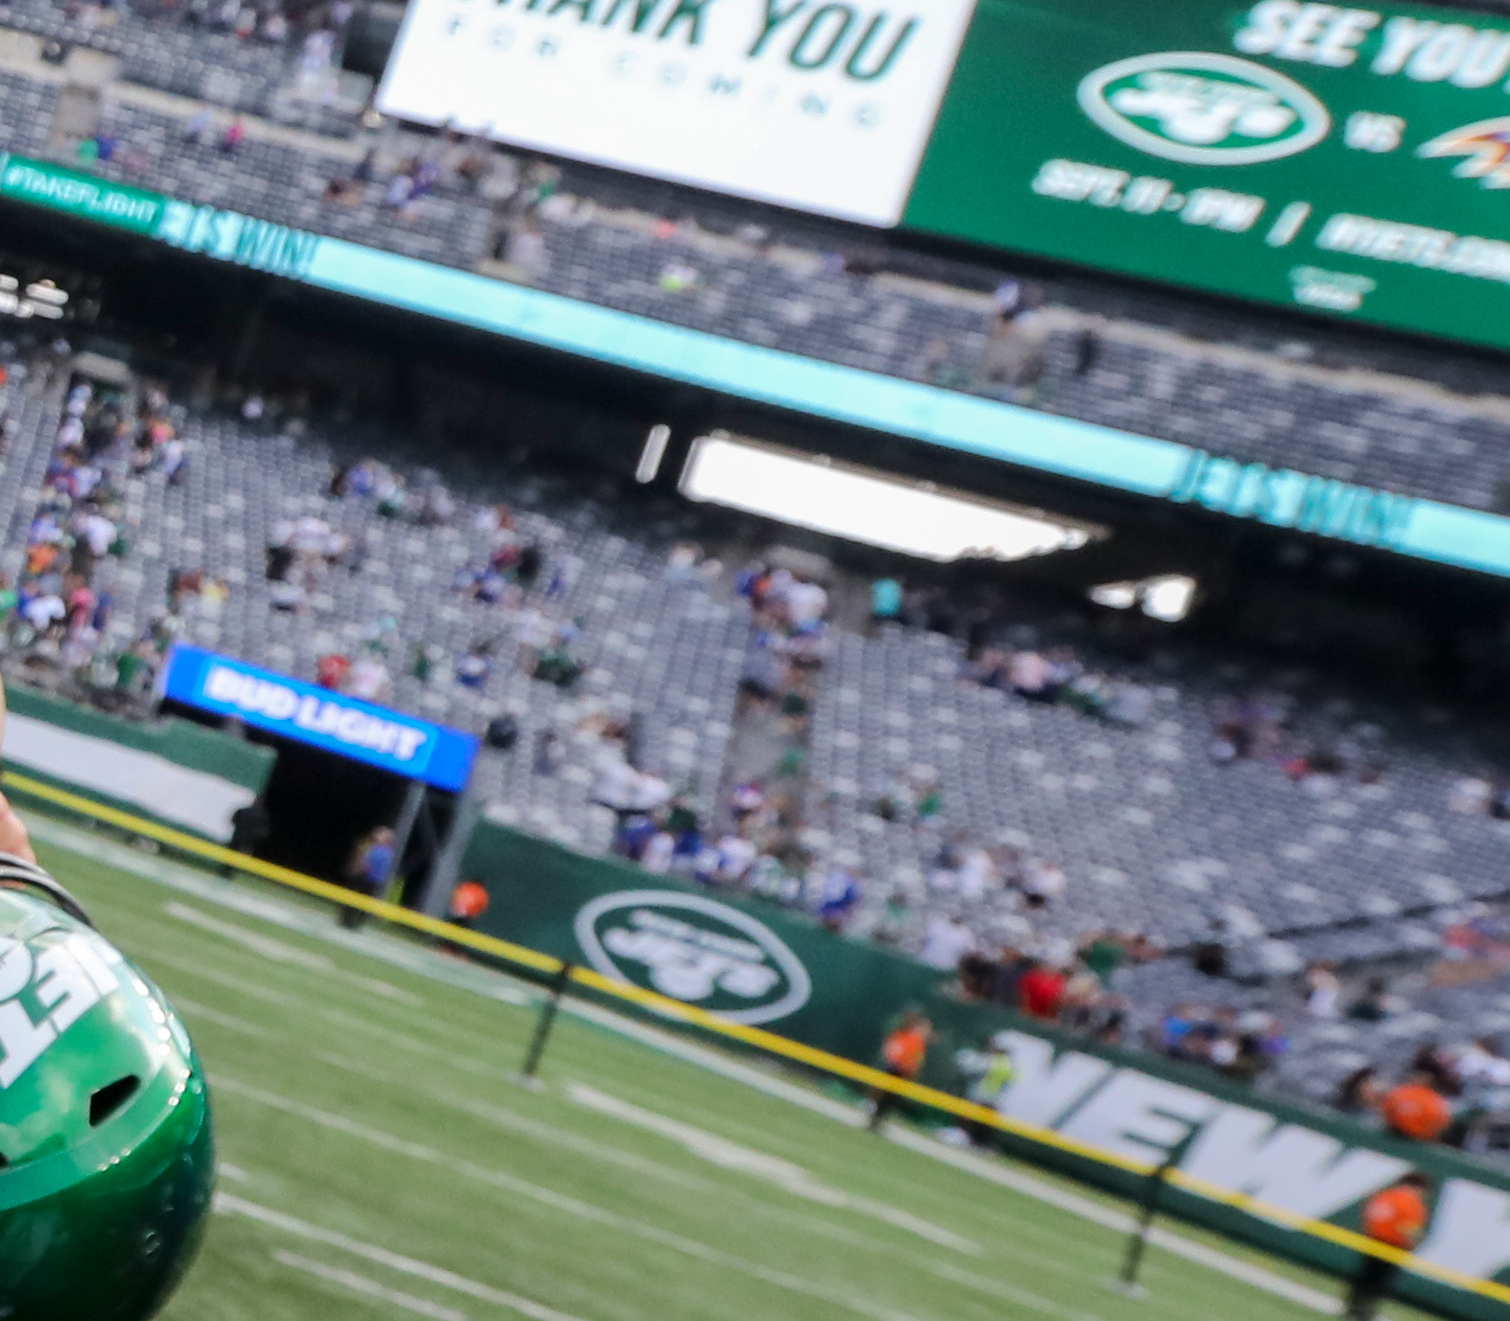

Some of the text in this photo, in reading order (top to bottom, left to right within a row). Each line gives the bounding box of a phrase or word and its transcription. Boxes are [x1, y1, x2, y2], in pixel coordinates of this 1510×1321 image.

[201, 665, 428, 762] BUD LIGHT
[987, 1028, 1414, 1234] NEW
